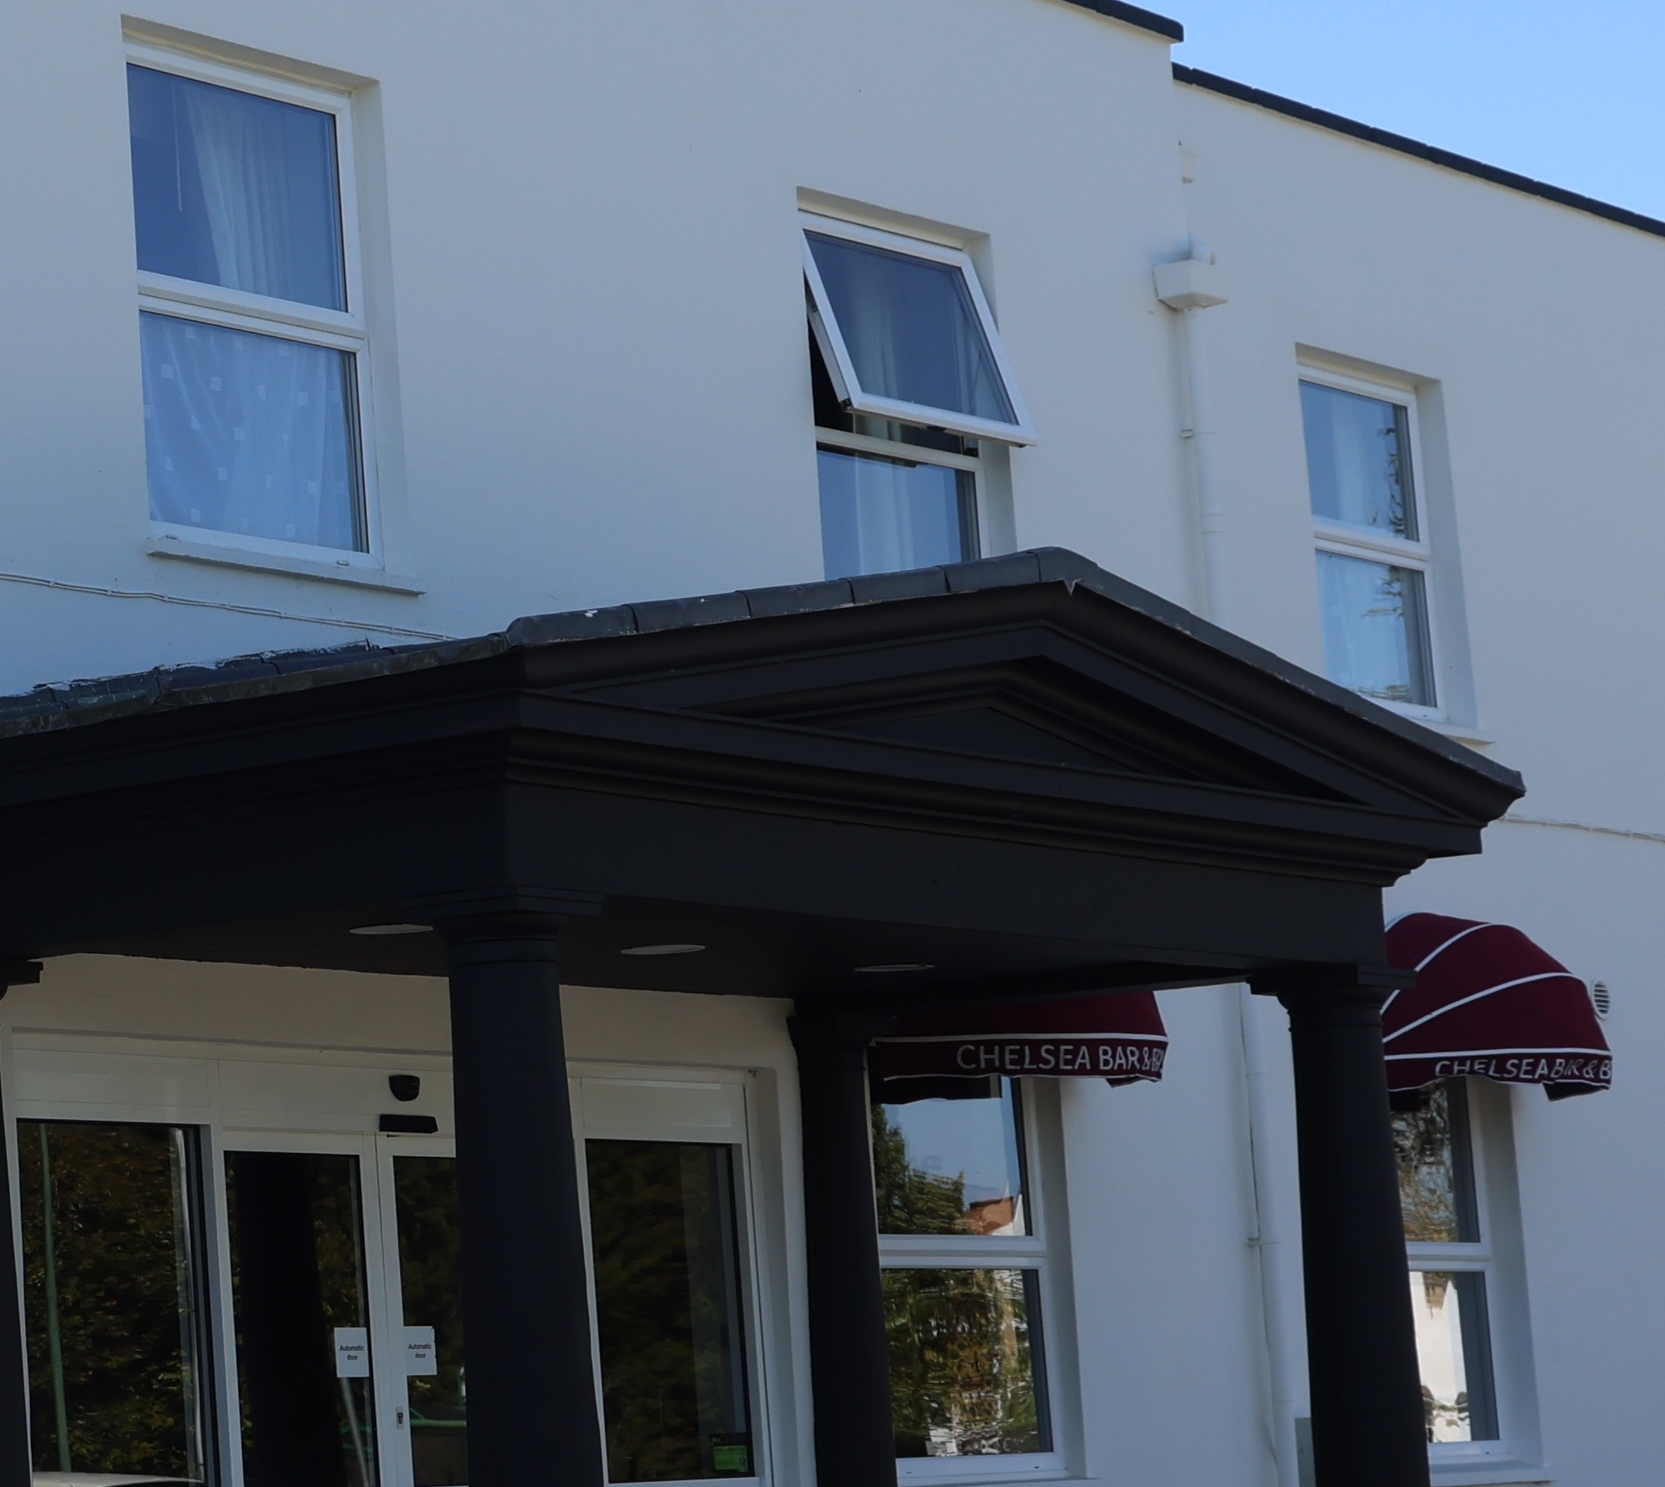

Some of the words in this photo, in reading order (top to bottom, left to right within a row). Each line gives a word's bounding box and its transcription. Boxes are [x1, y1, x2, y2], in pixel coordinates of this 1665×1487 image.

[956, 1044, 1091, 1071] CHELSEA
[1098, 1045, 1141, 1071] BAR
[1434, 1058, 1549, 1080] CHELSEA
[1582, 1060, 1598, 1079] &
[339, 1344, 364, 1352] Automatic
[408, 1343, 432, 1351] Automatic
